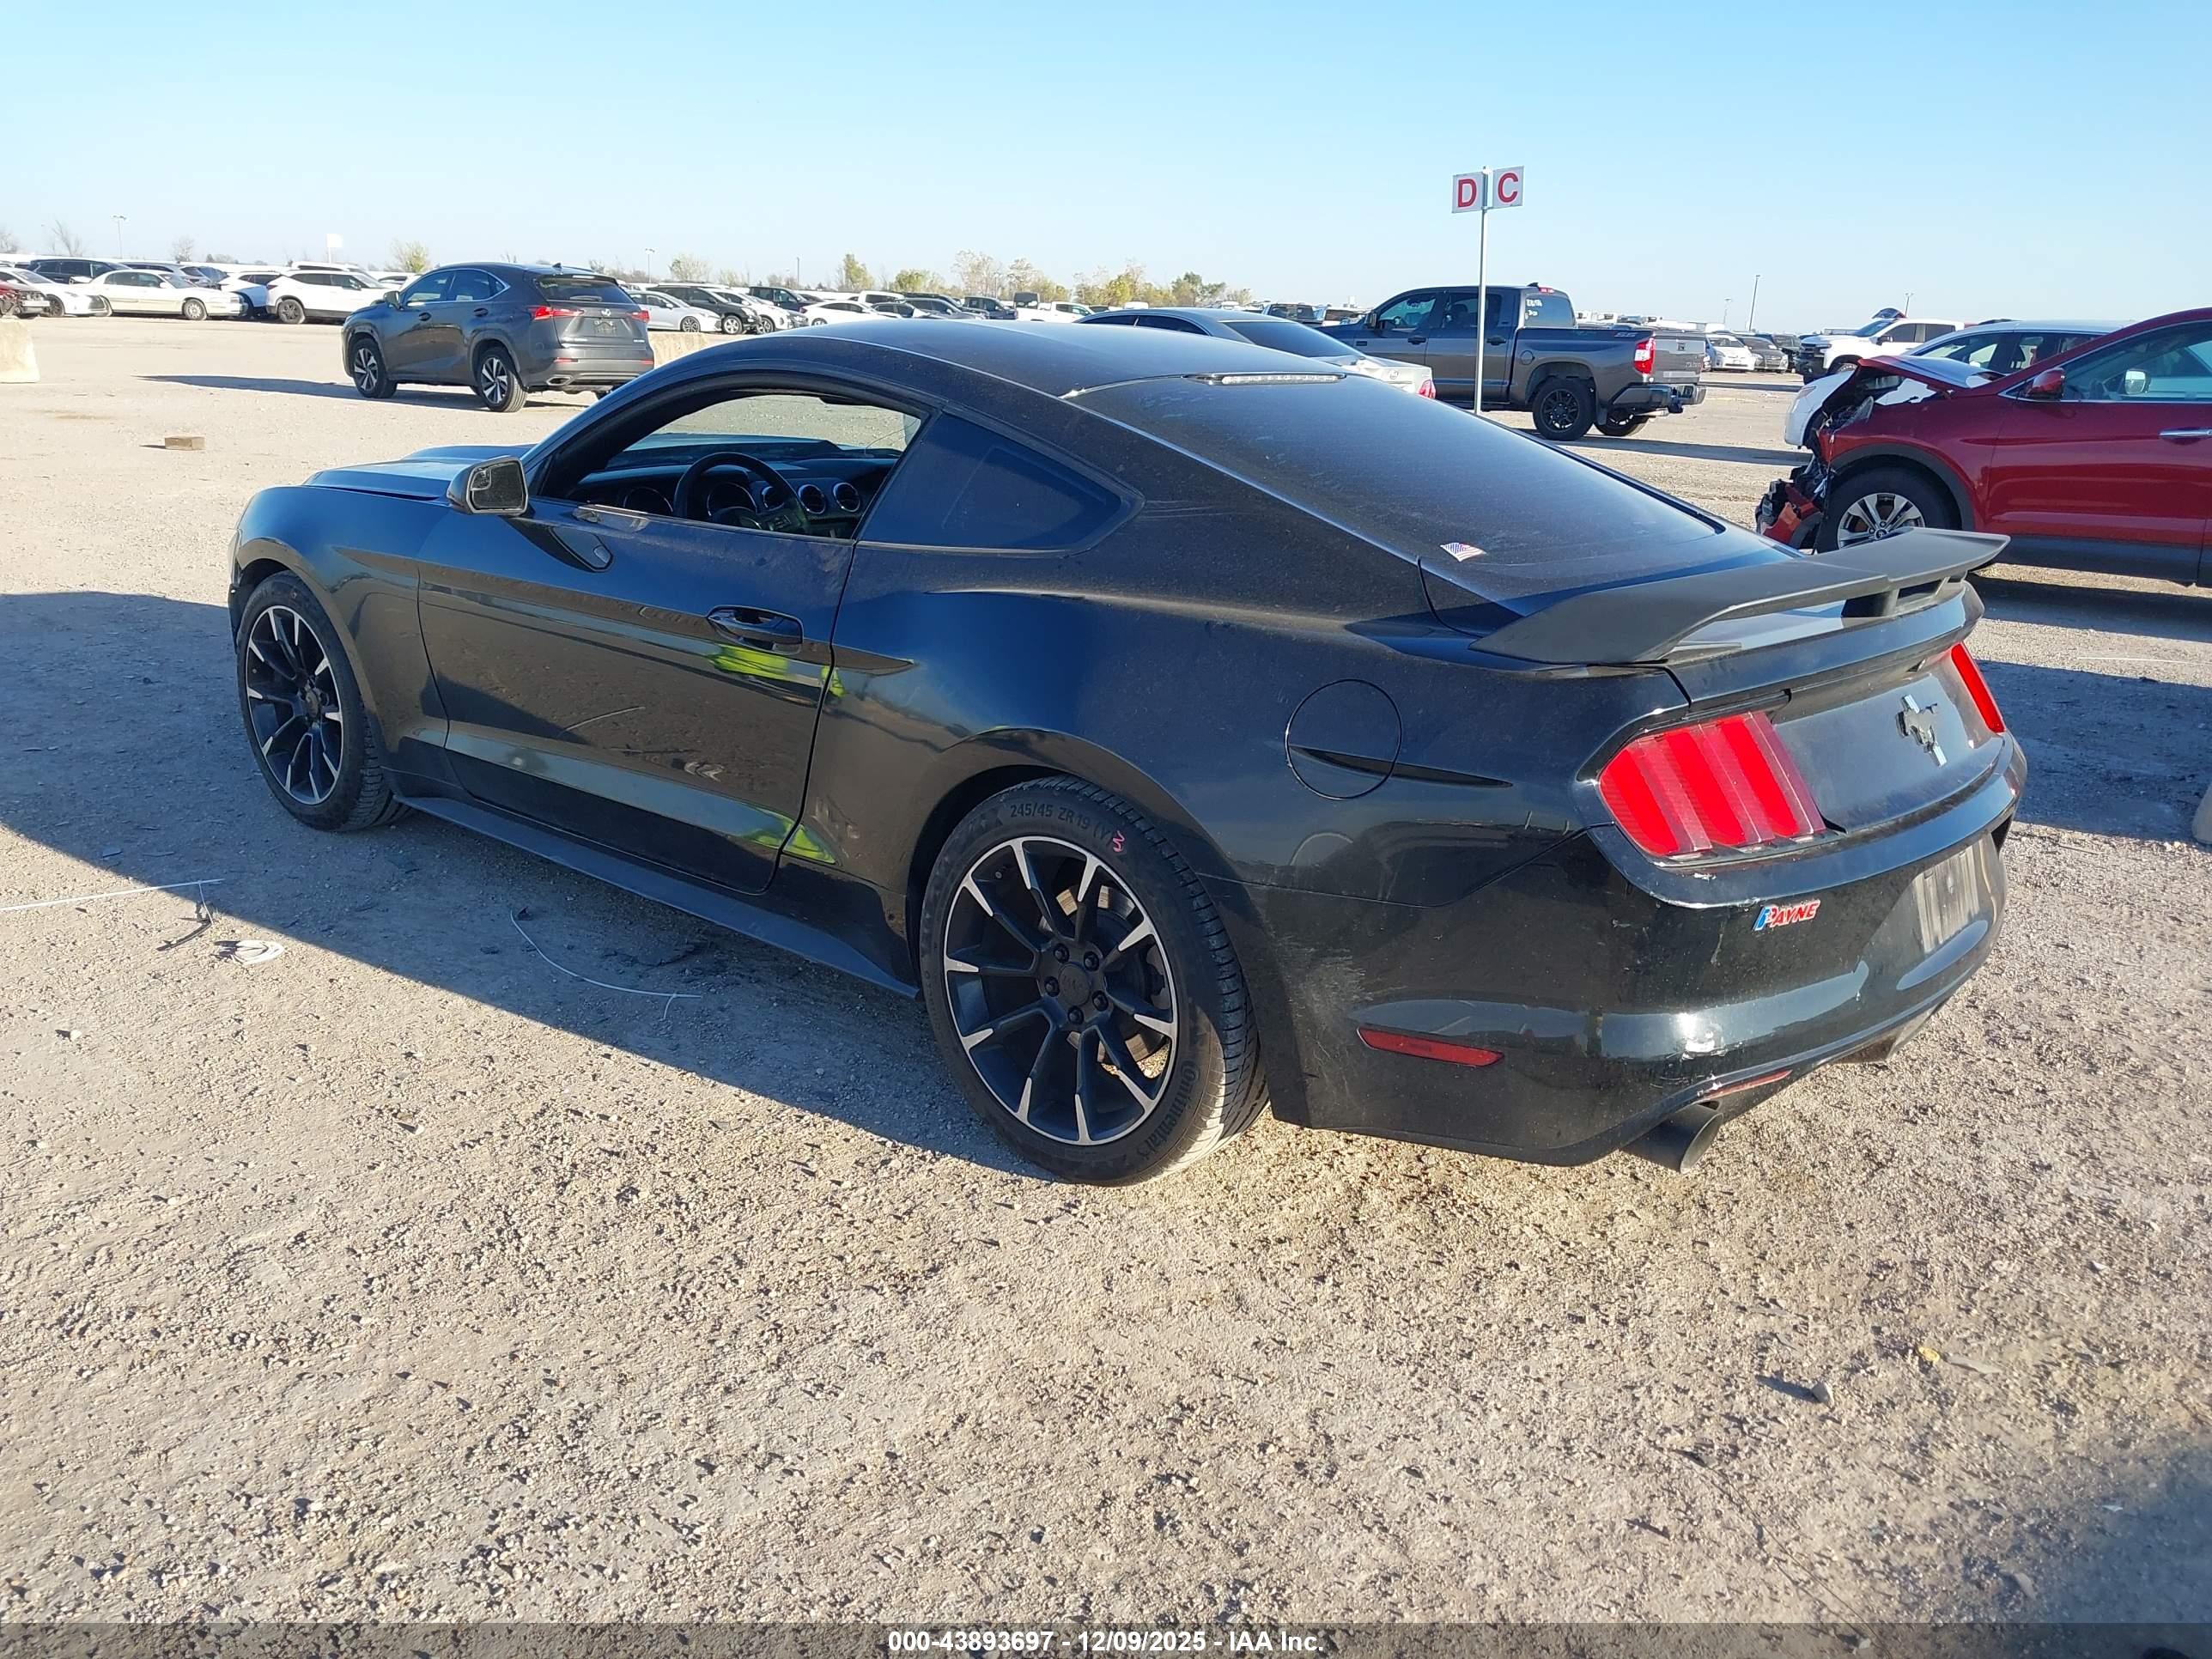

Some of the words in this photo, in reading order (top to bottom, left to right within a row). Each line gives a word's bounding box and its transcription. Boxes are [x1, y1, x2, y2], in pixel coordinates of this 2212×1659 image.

[1458, 178, 1477, 207] D
[1498, 172, 1519, 203] C
[1010, 803, 1054, 817] 245/45
[1753, 899, 1820, 931] PAYNE
